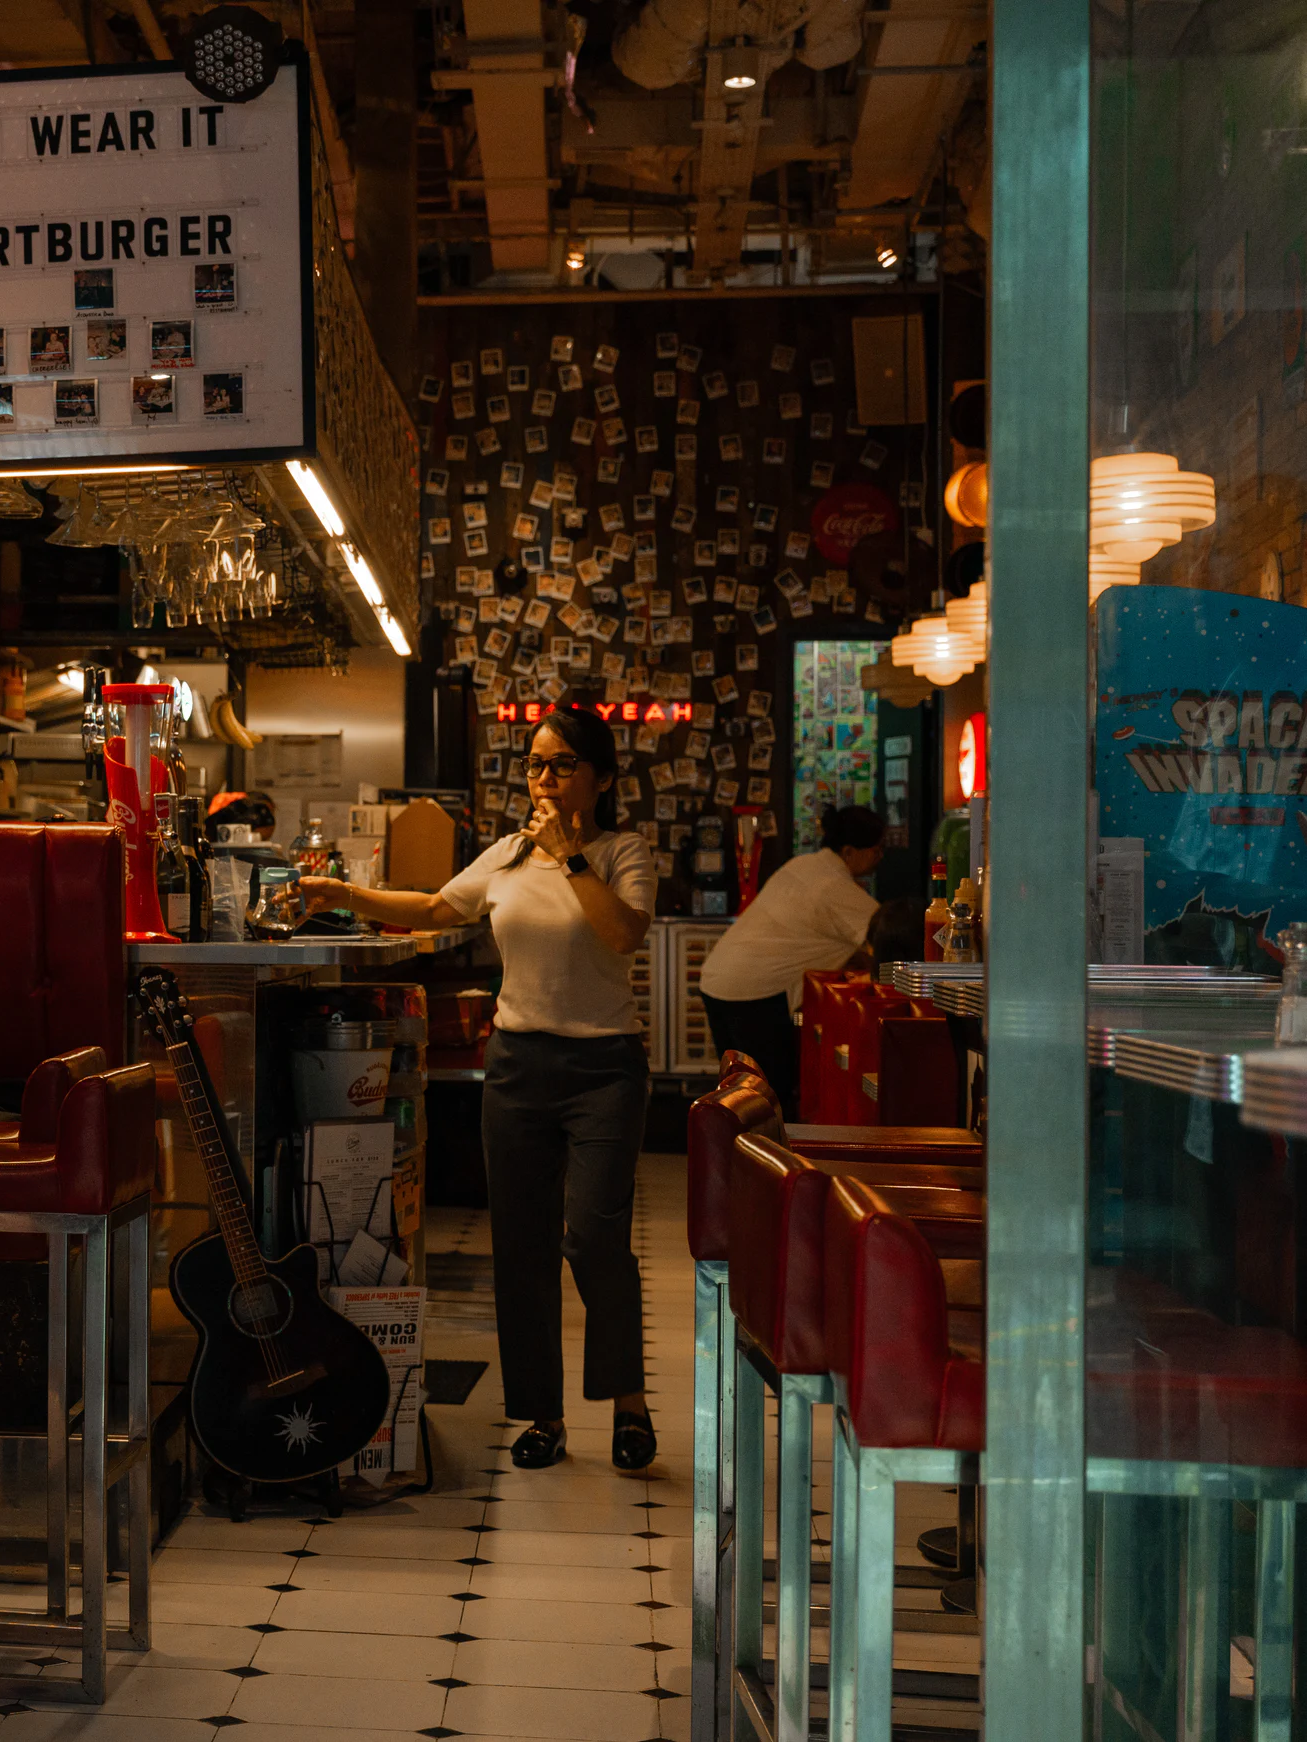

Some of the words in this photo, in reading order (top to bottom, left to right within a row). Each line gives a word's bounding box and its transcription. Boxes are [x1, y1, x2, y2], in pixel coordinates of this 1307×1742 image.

[30, 110, 156, 156] WEAR
[182, 106, 224, 147] IT
[596, 702, 693, 722] YEAH
[1172, 695, 1307, 749] SPAC
[1125, 752, 1307, 795] INVADE
[388, 1292, 399, 1300] FREE
[378, 1336, 386, 1345] &
[390, 1335, 416, 1345] BUN
